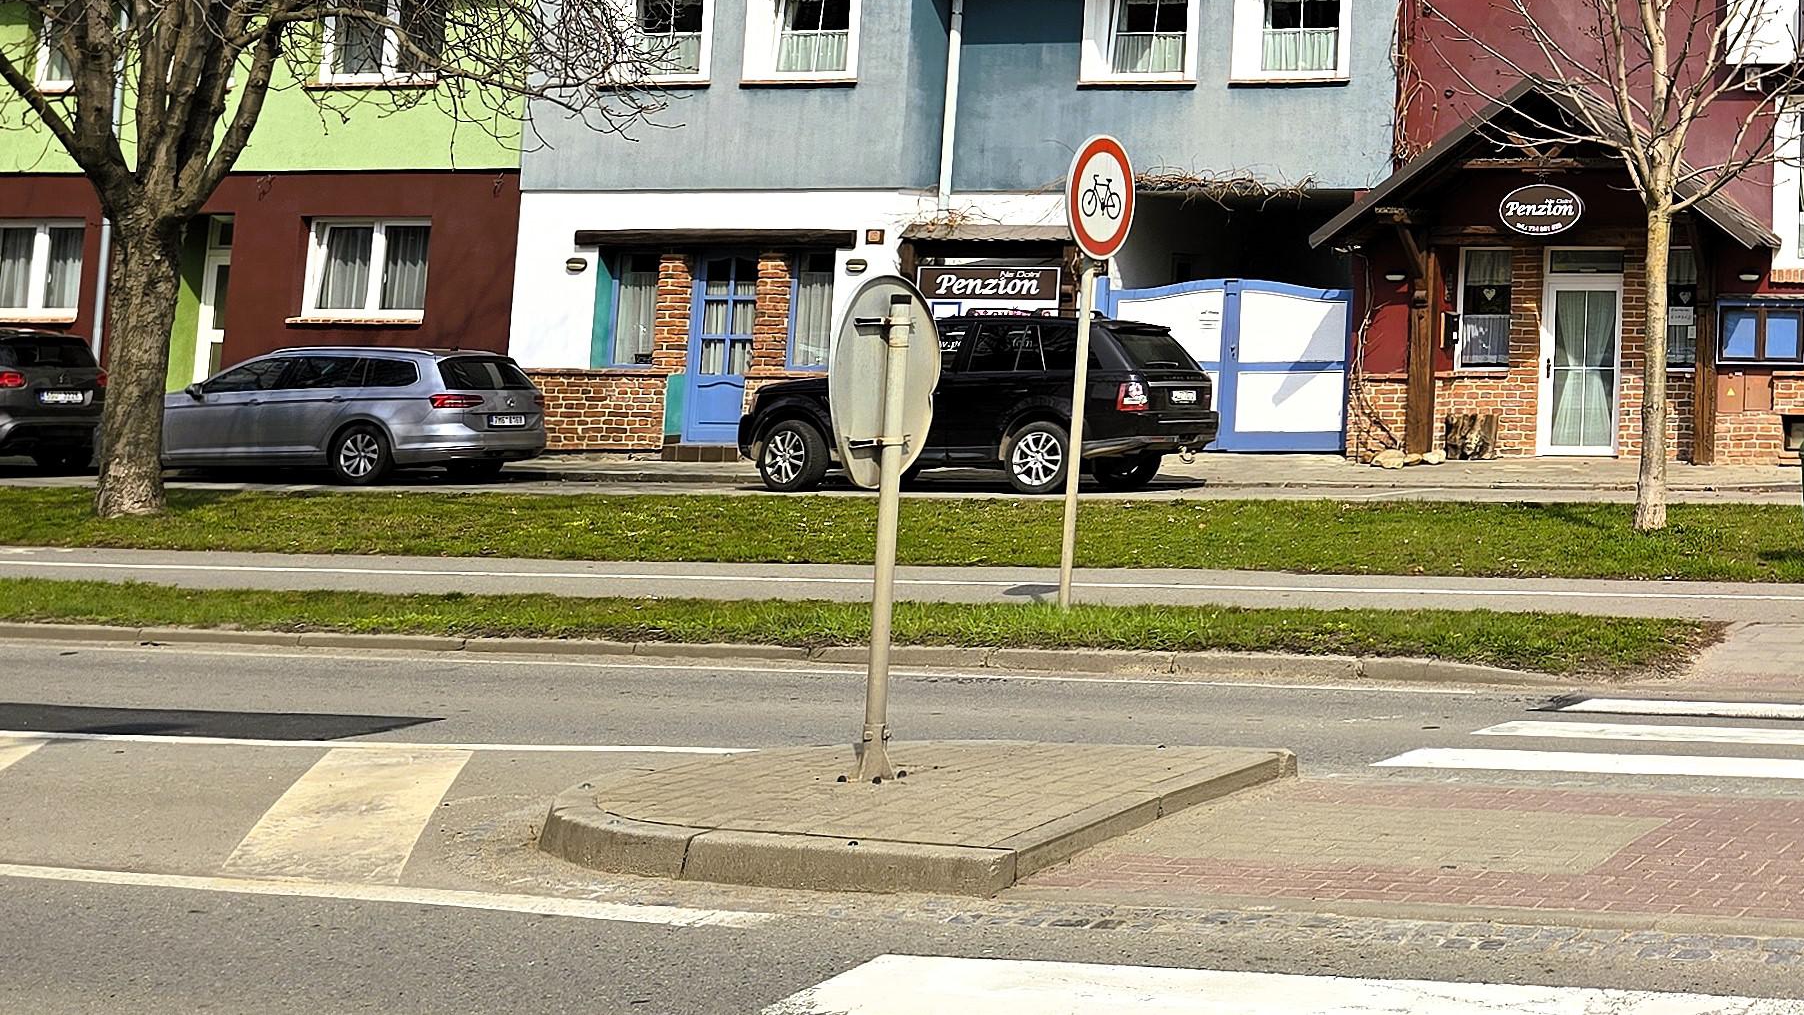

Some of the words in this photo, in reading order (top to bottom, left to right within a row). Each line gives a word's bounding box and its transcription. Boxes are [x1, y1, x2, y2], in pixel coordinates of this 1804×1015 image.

[1505, 201, 1575, 217] Penzion
[999, 270, 1014, 278] Na
[935, 274, 1041, 295] Penzion
